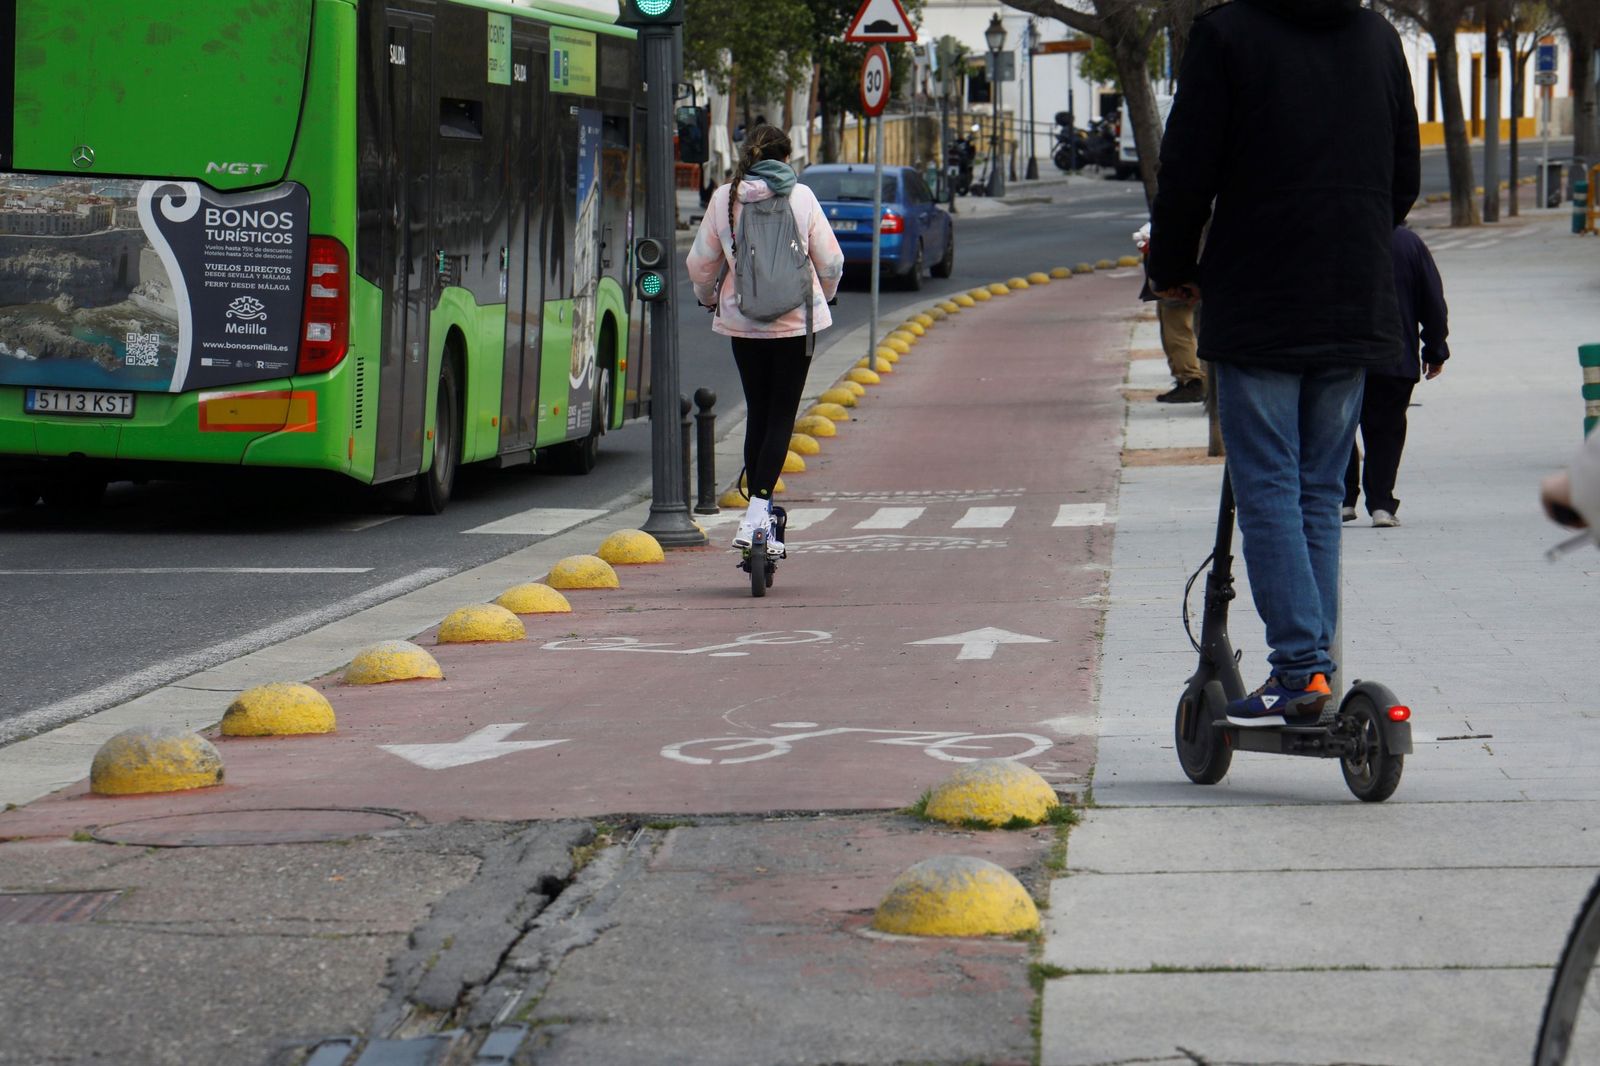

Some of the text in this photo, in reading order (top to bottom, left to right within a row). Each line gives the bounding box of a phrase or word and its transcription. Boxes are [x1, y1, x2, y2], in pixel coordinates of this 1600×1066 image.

[867, 69, 882, 93] 30
[205, 161, 269, 175] NGT
[205, 208, 294, 230] BONOS
[205, 228, 293, 245] TURÍSTICOS
[205, 263, 292, 274] VUELOS DIRECTOS
[262, 273, 291, 281] MÁLAGA
[257, 282, 290, 291] MÁLAGA
[225, 323, 267, 335] Melilla
[202, 342, 289, 352] www.bonosmelilla.es
[39, 392, 129, 413] 5113 KST
